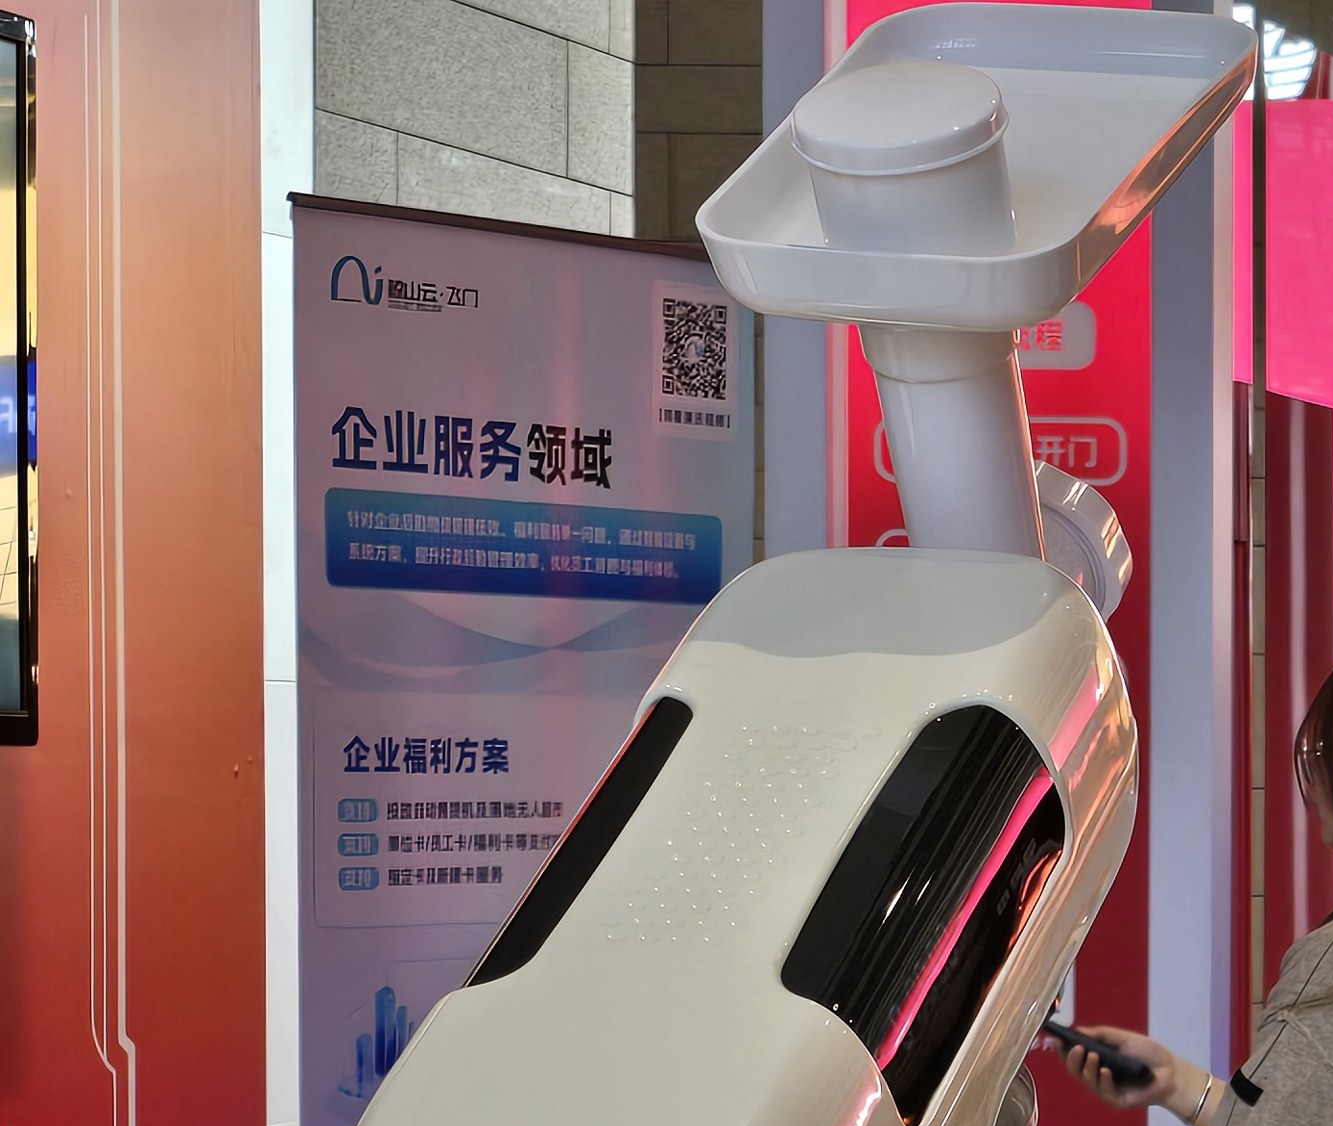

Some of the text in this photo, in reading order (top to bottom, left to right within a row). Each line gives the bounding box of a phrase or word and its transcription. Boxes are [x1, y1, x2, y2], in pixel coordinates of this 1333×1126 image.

[332, 406, 612, 489] 企业服务领域
[343, 736, 510, 775] 企业福利方案
